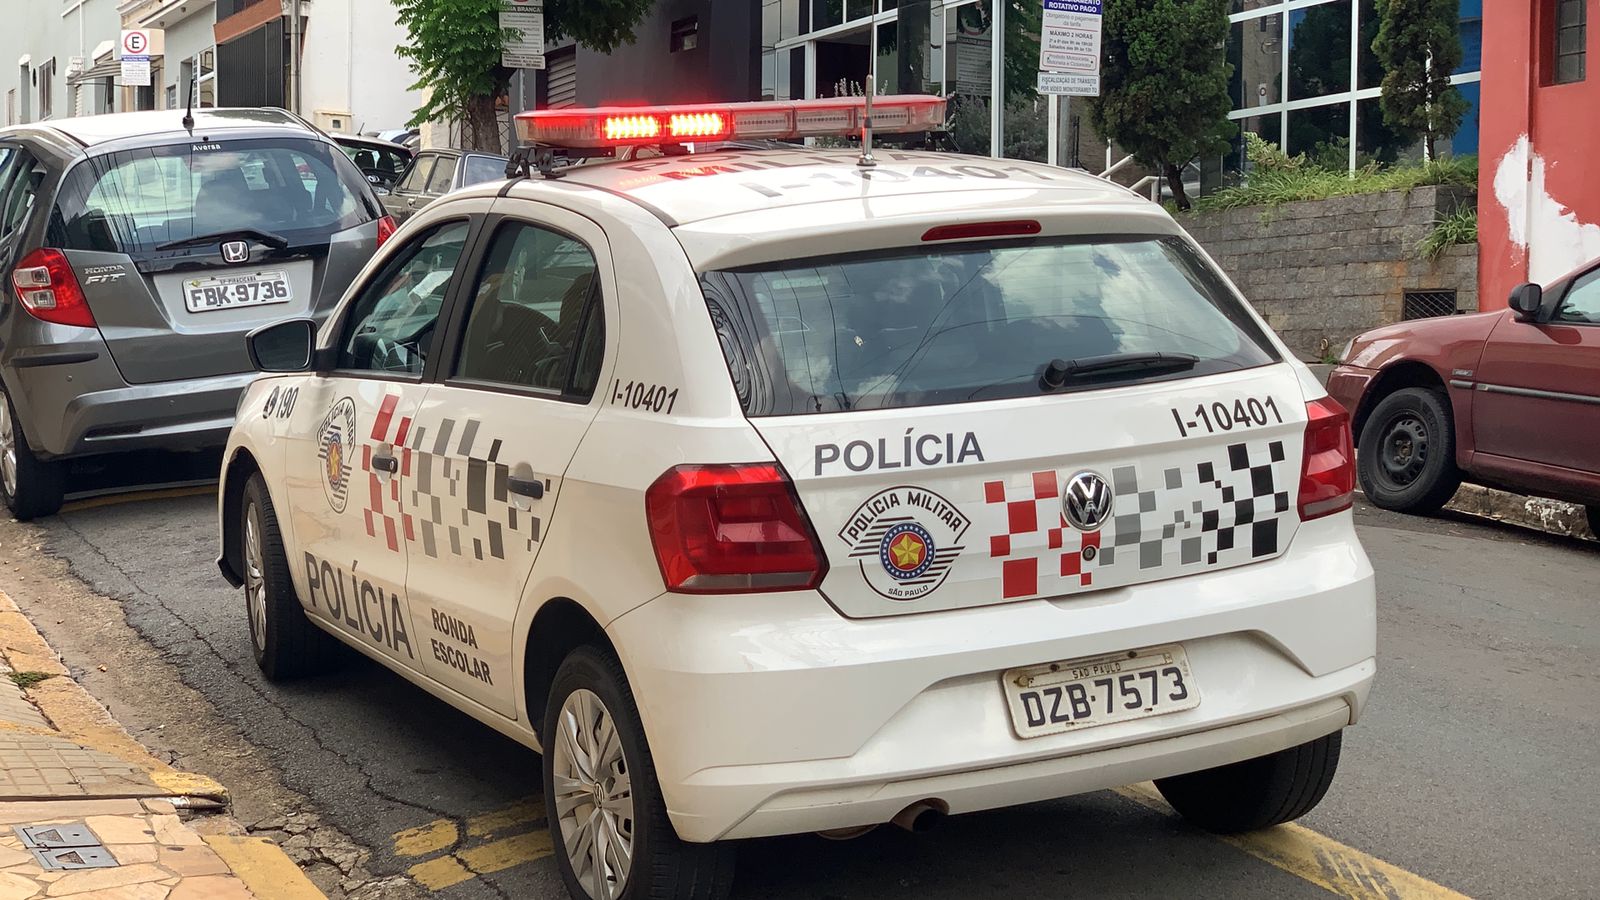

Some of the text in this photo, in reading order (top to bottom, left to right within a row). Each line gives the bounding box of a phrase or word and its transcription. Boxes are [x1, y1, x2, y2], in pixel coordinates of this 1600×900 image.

[1048, 2, 1079, 10] ROTATIVO
[1080, 4, 1097, 13] PAGO
[131, 36, 140, 49] E
[84, 264, 125, 274] HONDA
[85, 273, 126, 285] FIT
[275, 386, 299, 419] 190
[611, 378, 679, 415] I-10401
[1171, 395, 1283, 437] I-10401
[814, 427, 985, 476] POLÍCIA
[847, 491, 962, 541] POLÍCIA MILITAR
[305, 551, 415, 660] POLÍCIA
[888, 584, 929, 597] SÃO PAULO
[431, 608, 478, 649] RONDA
[431, 638, 494, 686] ESCOLAR
[1093, 662, 1121, 674] PAULO
